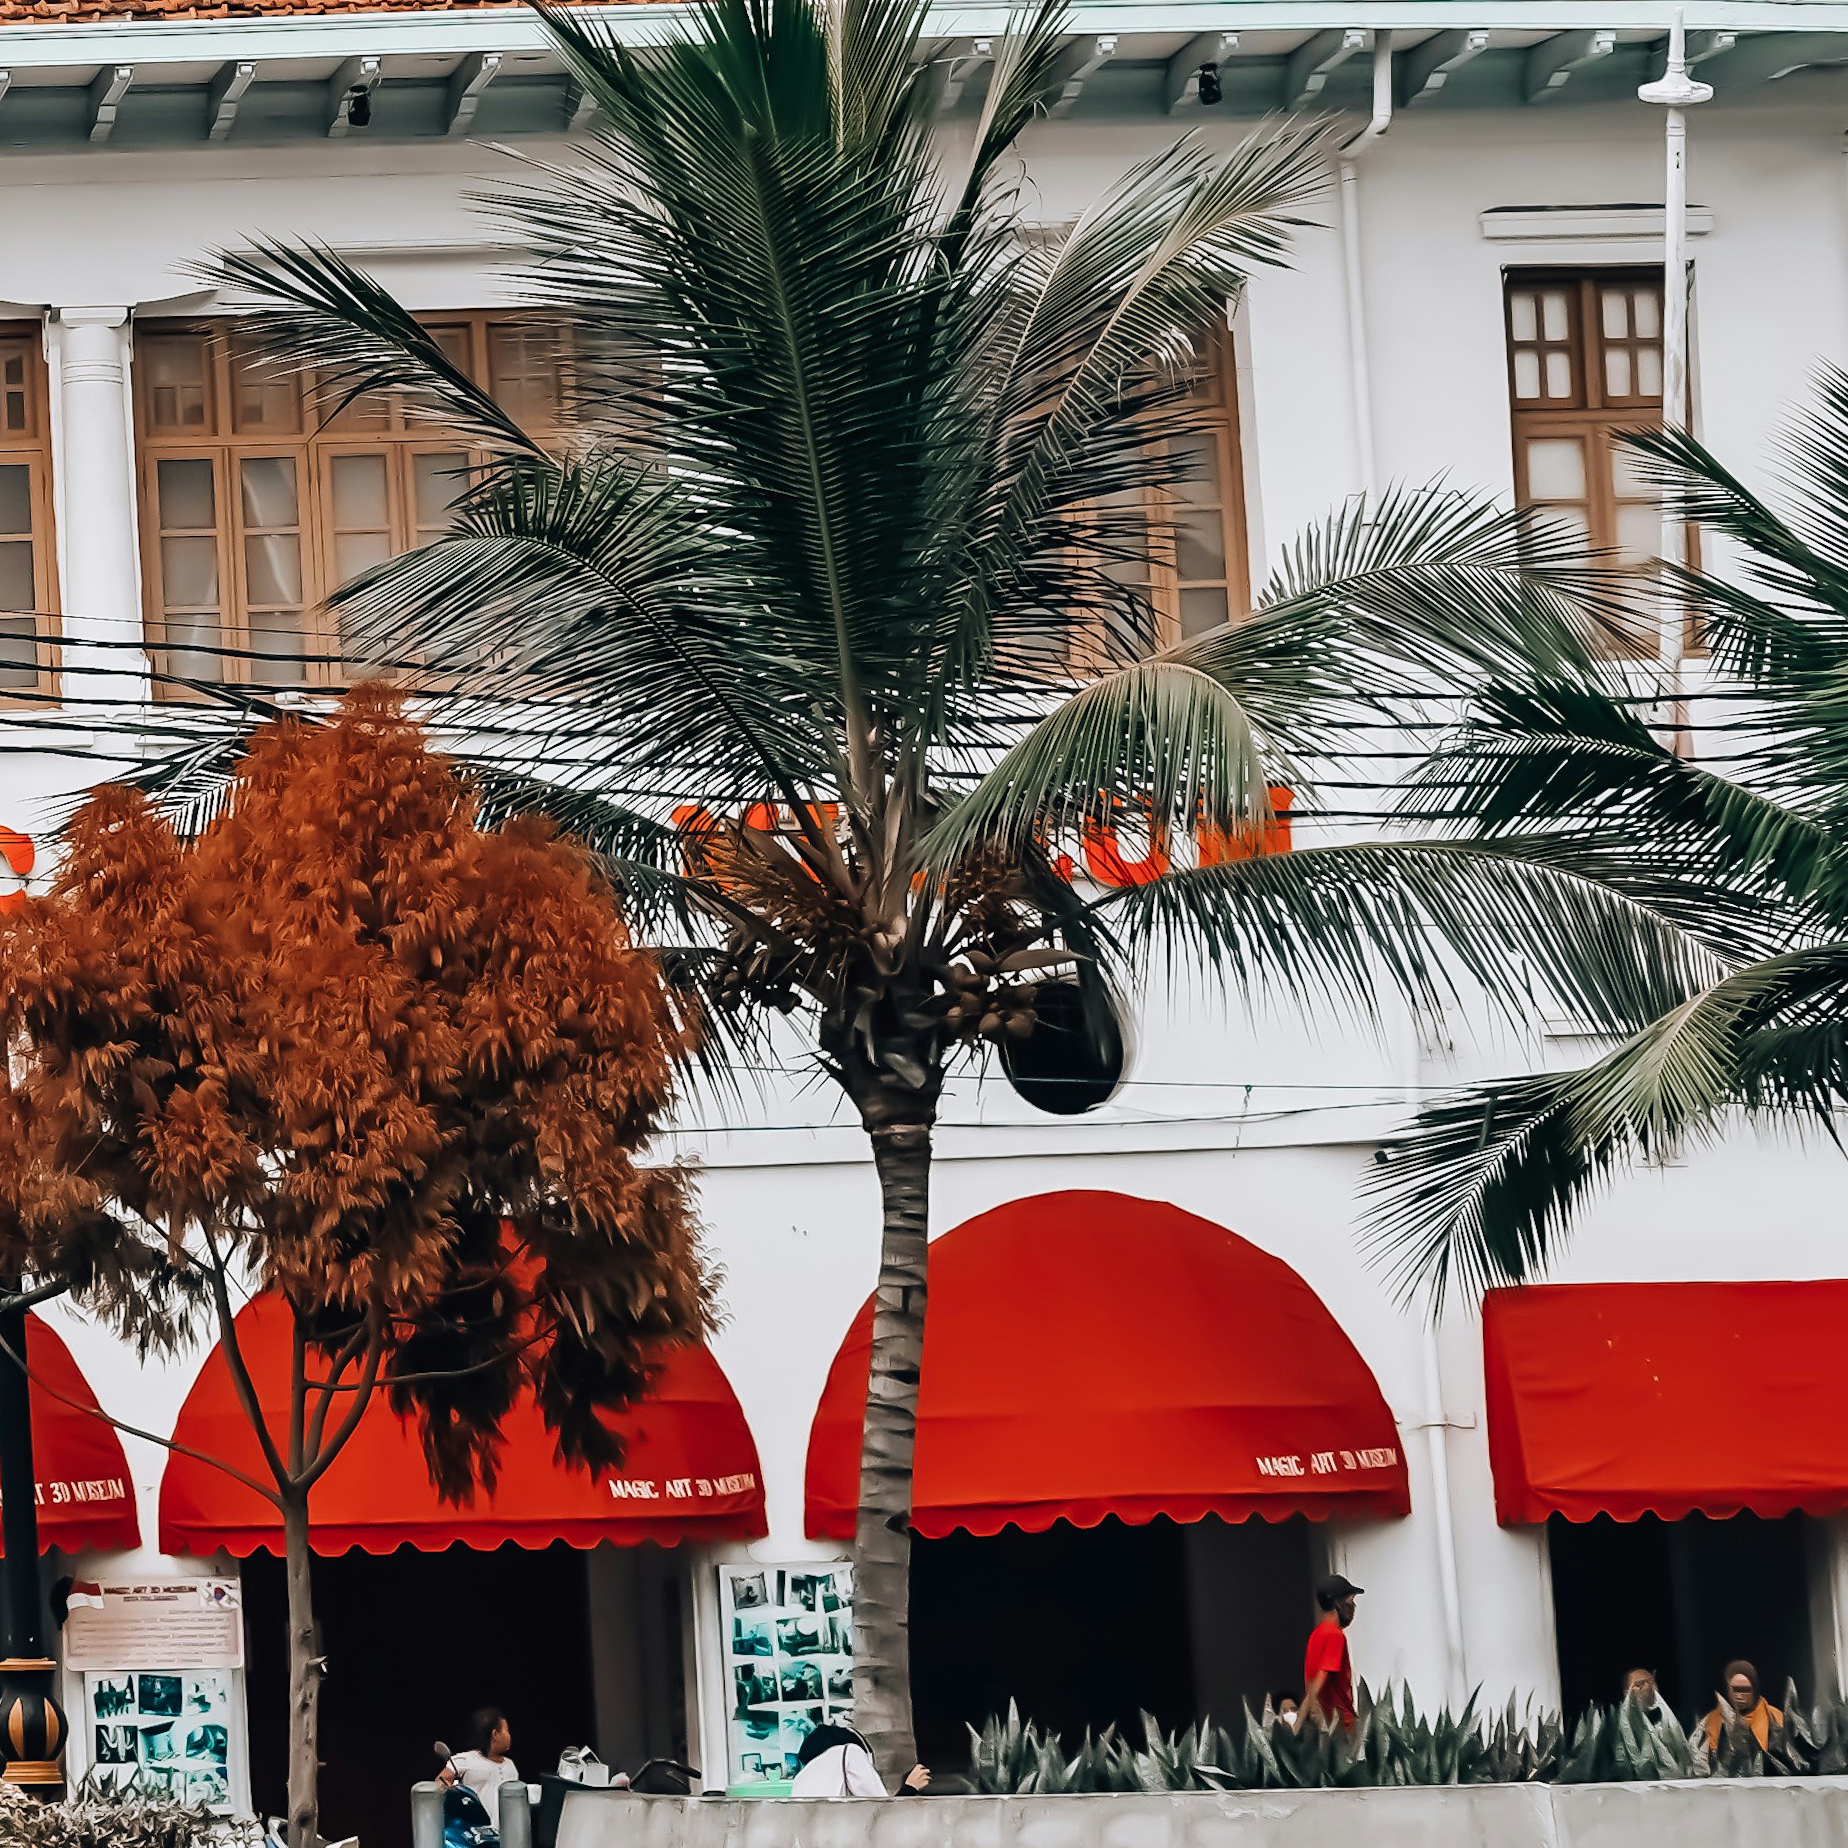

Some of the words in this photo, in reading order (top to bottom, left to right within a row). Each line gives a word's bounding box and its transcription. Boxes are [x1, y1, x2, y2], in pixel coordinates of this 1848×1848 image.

[49, 1481, 71, 1504] 3D
[608, 1479, 660, 1499] MAGIC
[665, 1478, 693, 1498] ART
